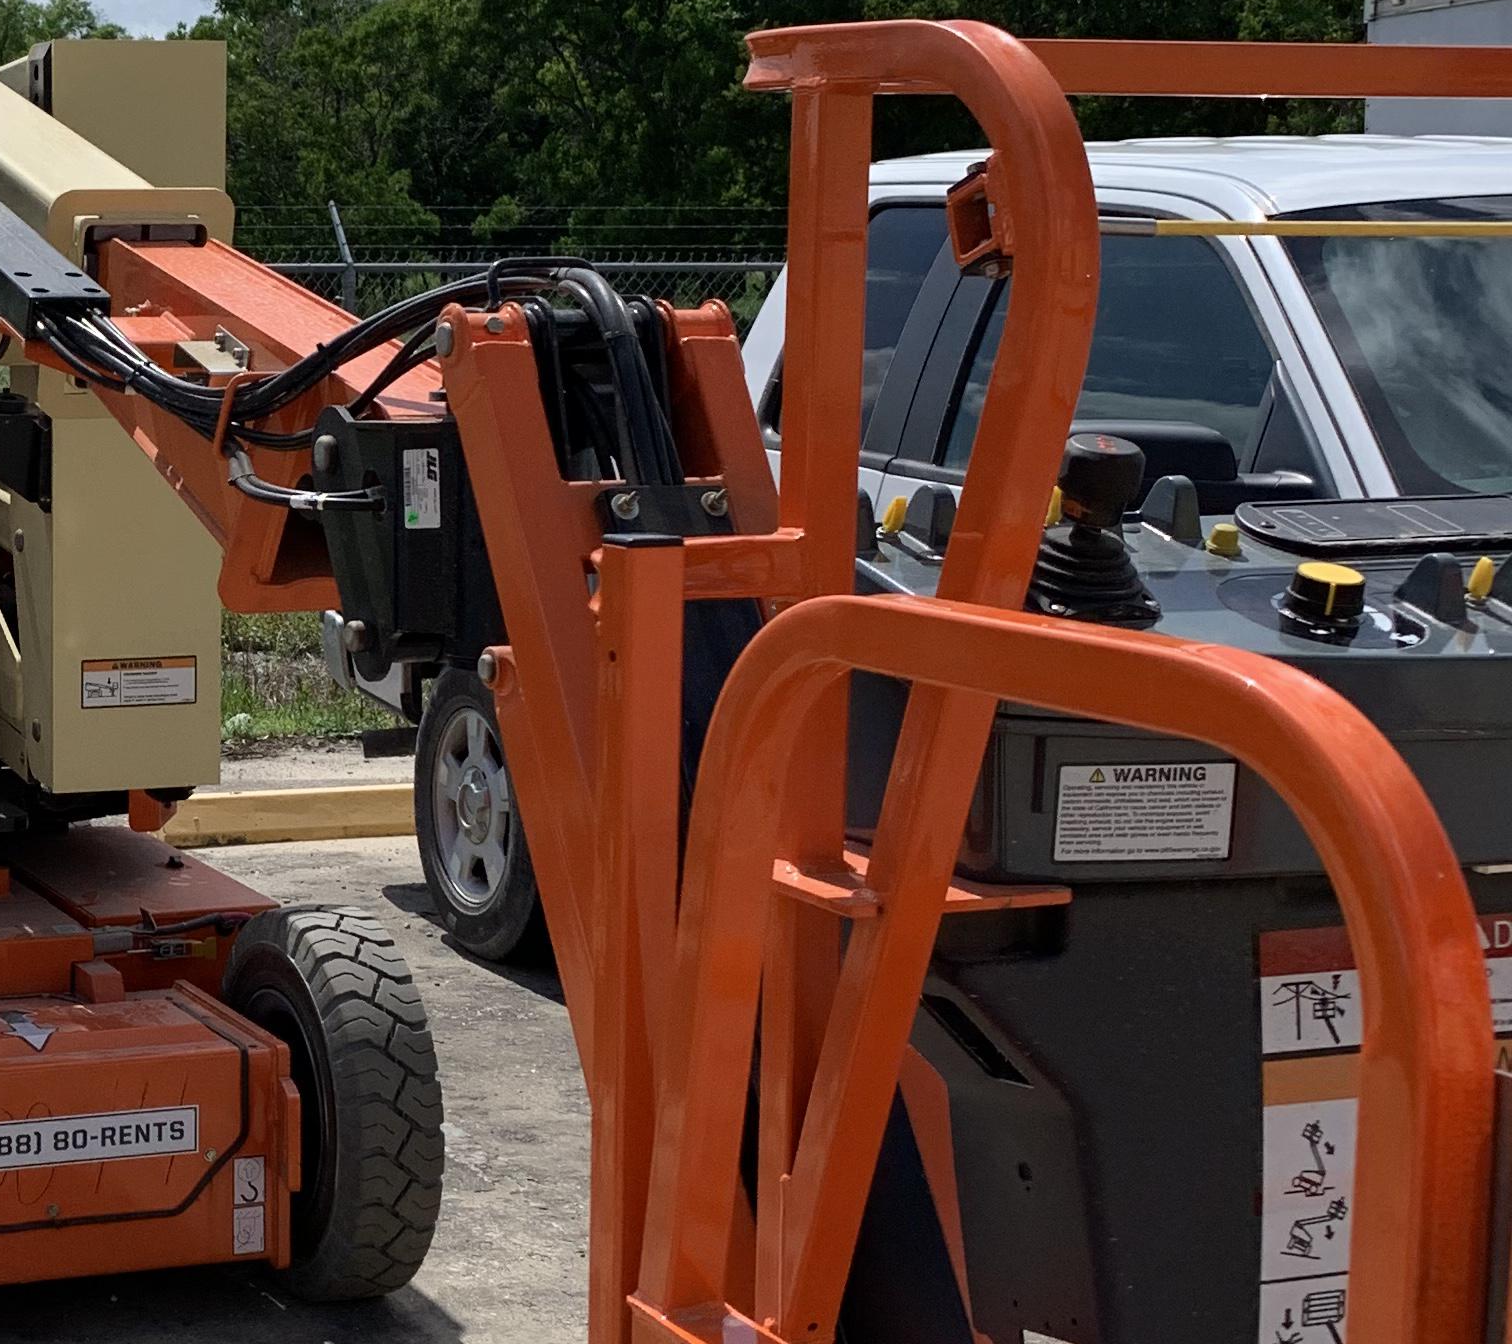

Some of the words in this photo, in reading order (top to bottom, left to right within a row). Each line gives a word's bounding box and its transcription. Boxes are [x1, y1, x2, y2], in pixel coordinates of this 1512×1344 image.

[426, 450, 438, 483] JLG
[120, 660, 163, 670] WARNING
[1113, 766, 1207, 783] WARNING
[53, 1120, 185, 1151] 80-RENTS
